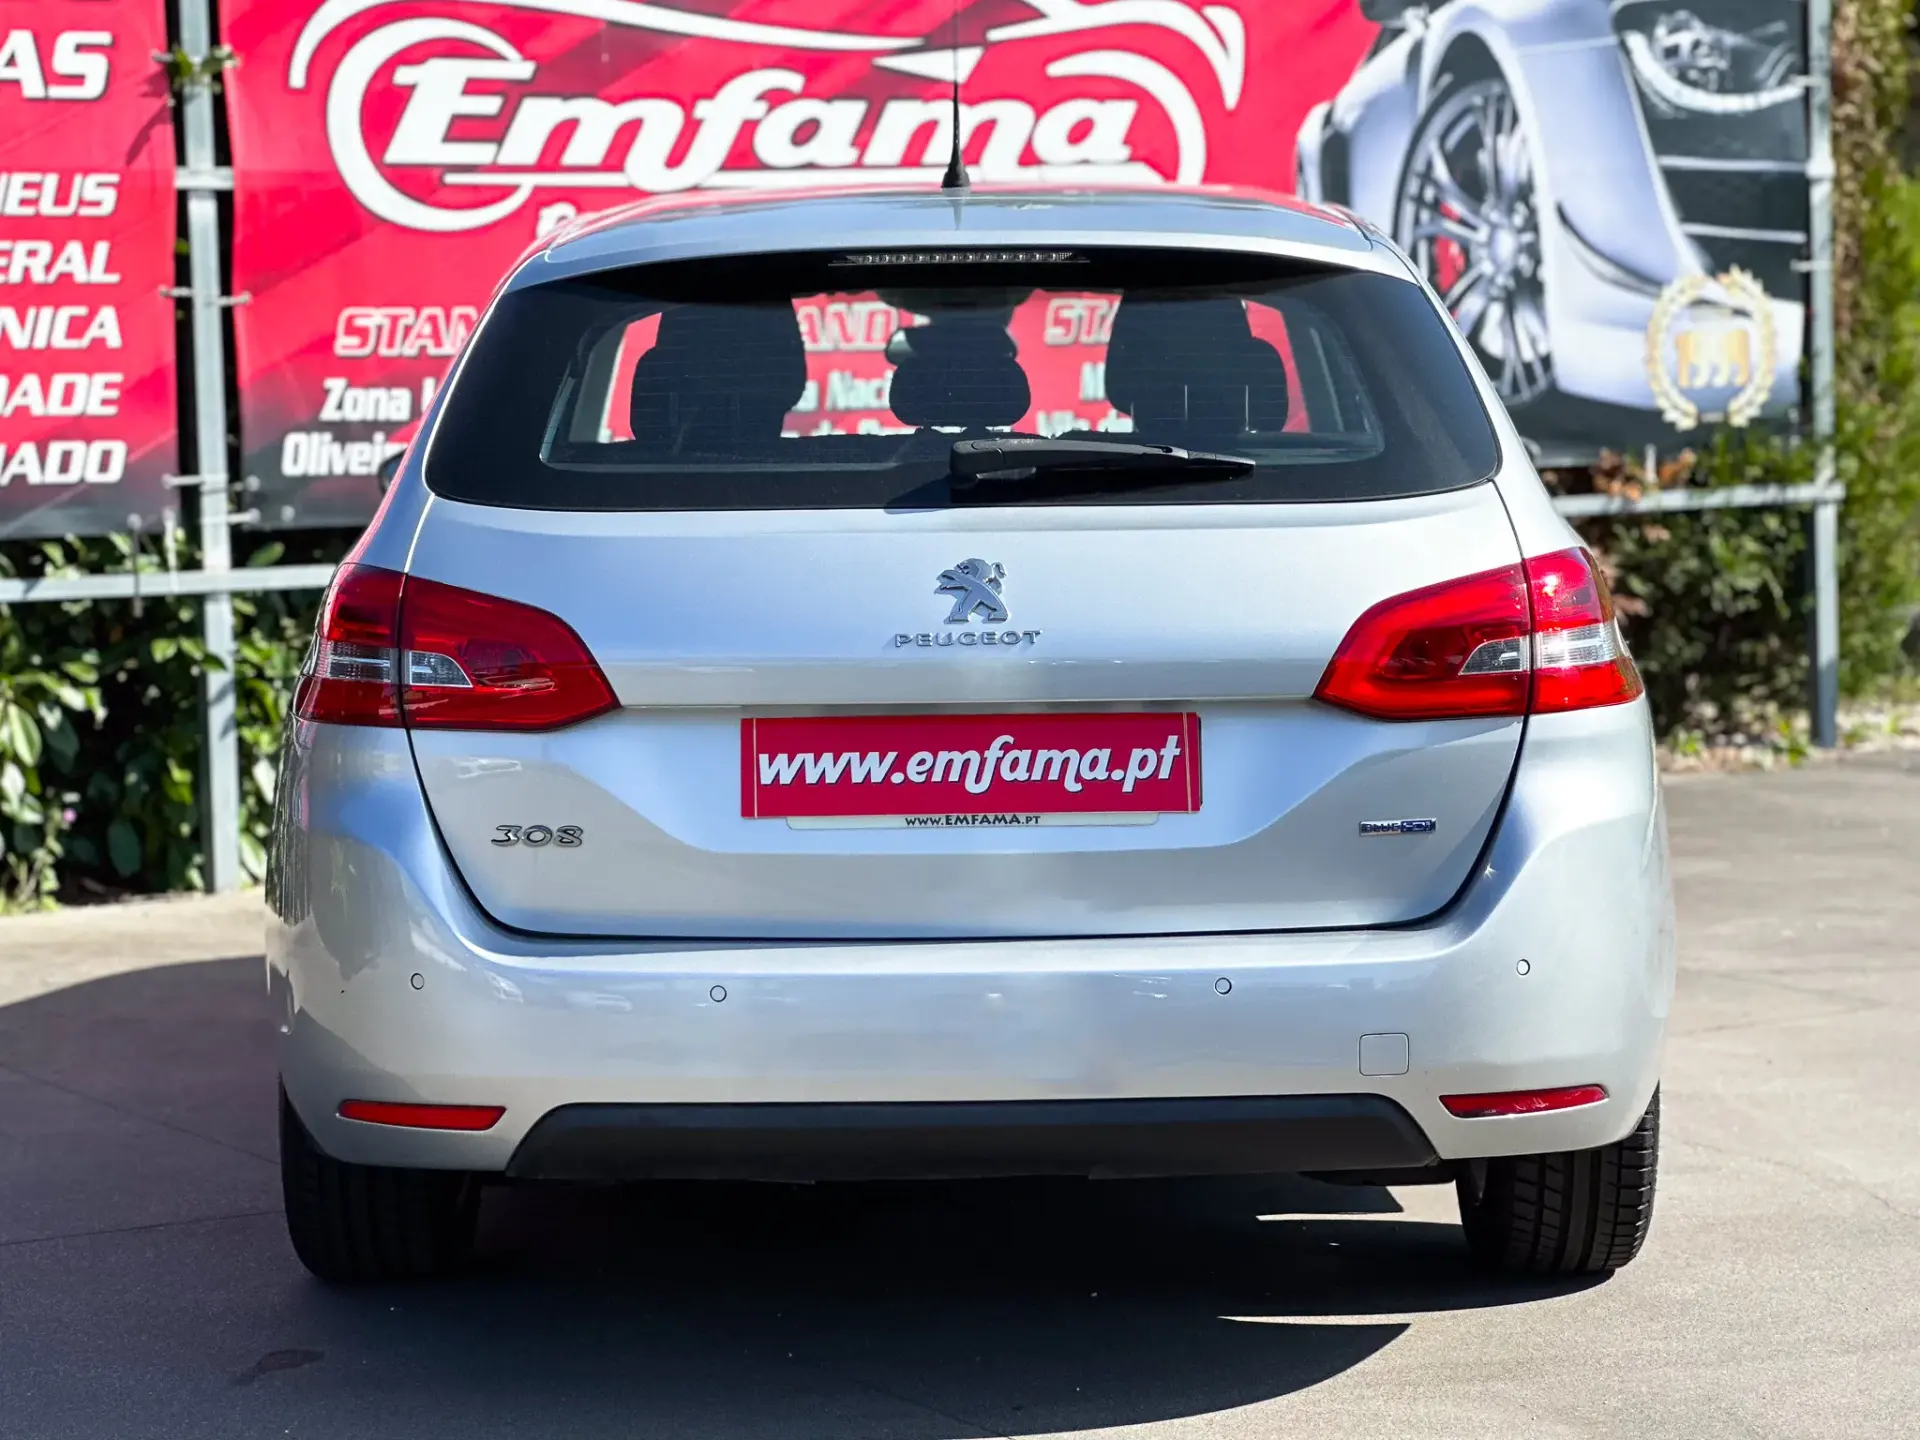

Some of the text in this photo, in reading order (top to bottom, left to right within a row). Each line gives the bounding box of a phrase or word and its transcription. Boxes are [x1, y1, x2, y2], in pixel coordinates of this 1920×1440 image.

[382, 57, 1139, 193] Emfama
[0, 172, 121, 217] EUS
[318, 377, 412, 422] Zona
[0, 440, 127, 486] ADO
[894, 629, 1043, 648] PEUGEOT
[758, 734, 1182, 794] www.emfama.pt
[490, 824, 585, 848] 308
[904, 813, 1042, 827] WWW.EMFAMA.PT
